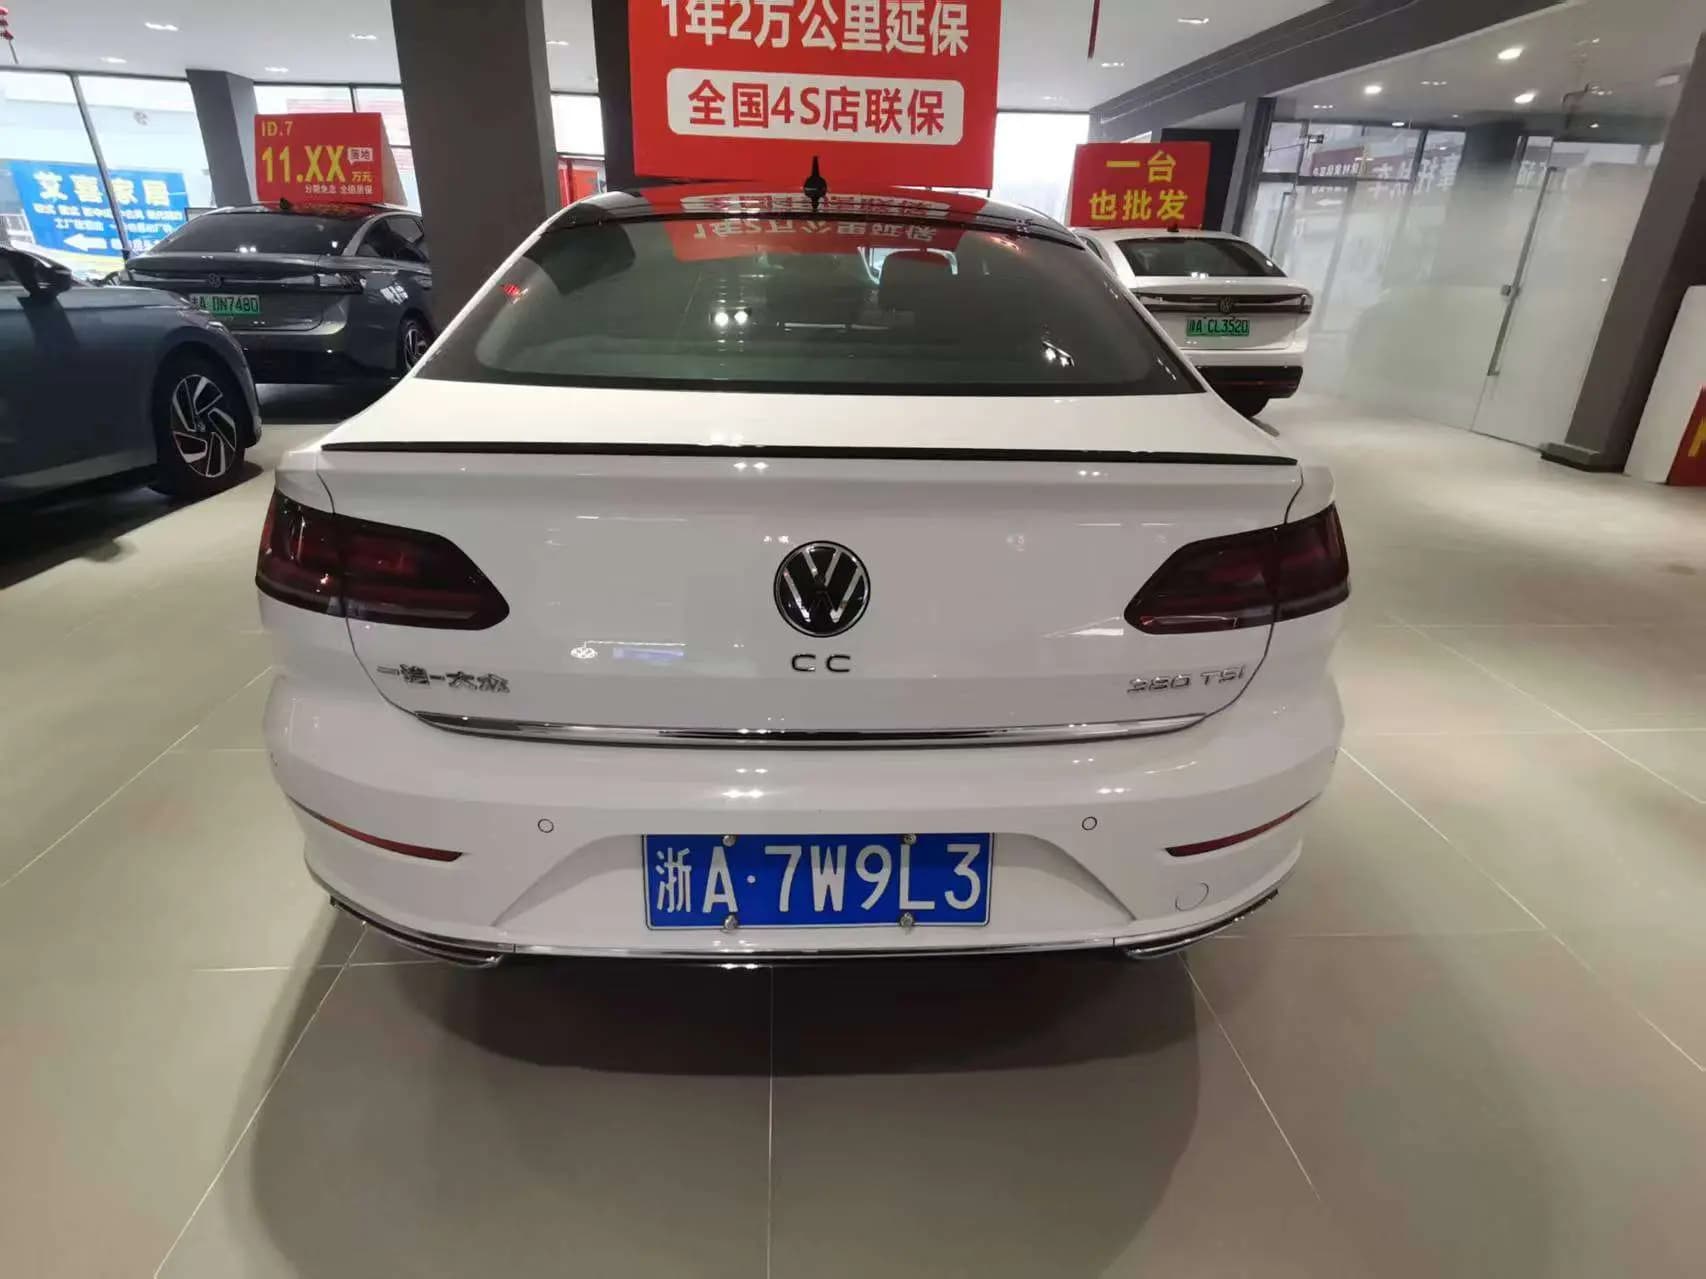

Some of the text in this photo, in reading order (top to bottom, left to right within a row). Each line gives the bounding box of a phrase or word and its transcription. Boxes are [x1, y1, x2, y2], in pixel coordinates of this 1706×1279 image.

[661, 0, 969, 56] 1年2万公里延保
[687, 78, 945, 136] 全国4S店联保
[262, 120, 293, 137] ID.7
[261, 145, 346, 184] 11.XX
[1105, 149, 1177, 183] 一台
[1088, 187, 1189, 221] 也批发
[1199, 665, 1245, 686] TSI
[656, 844, 982, 913] 浙A·7W9L3
